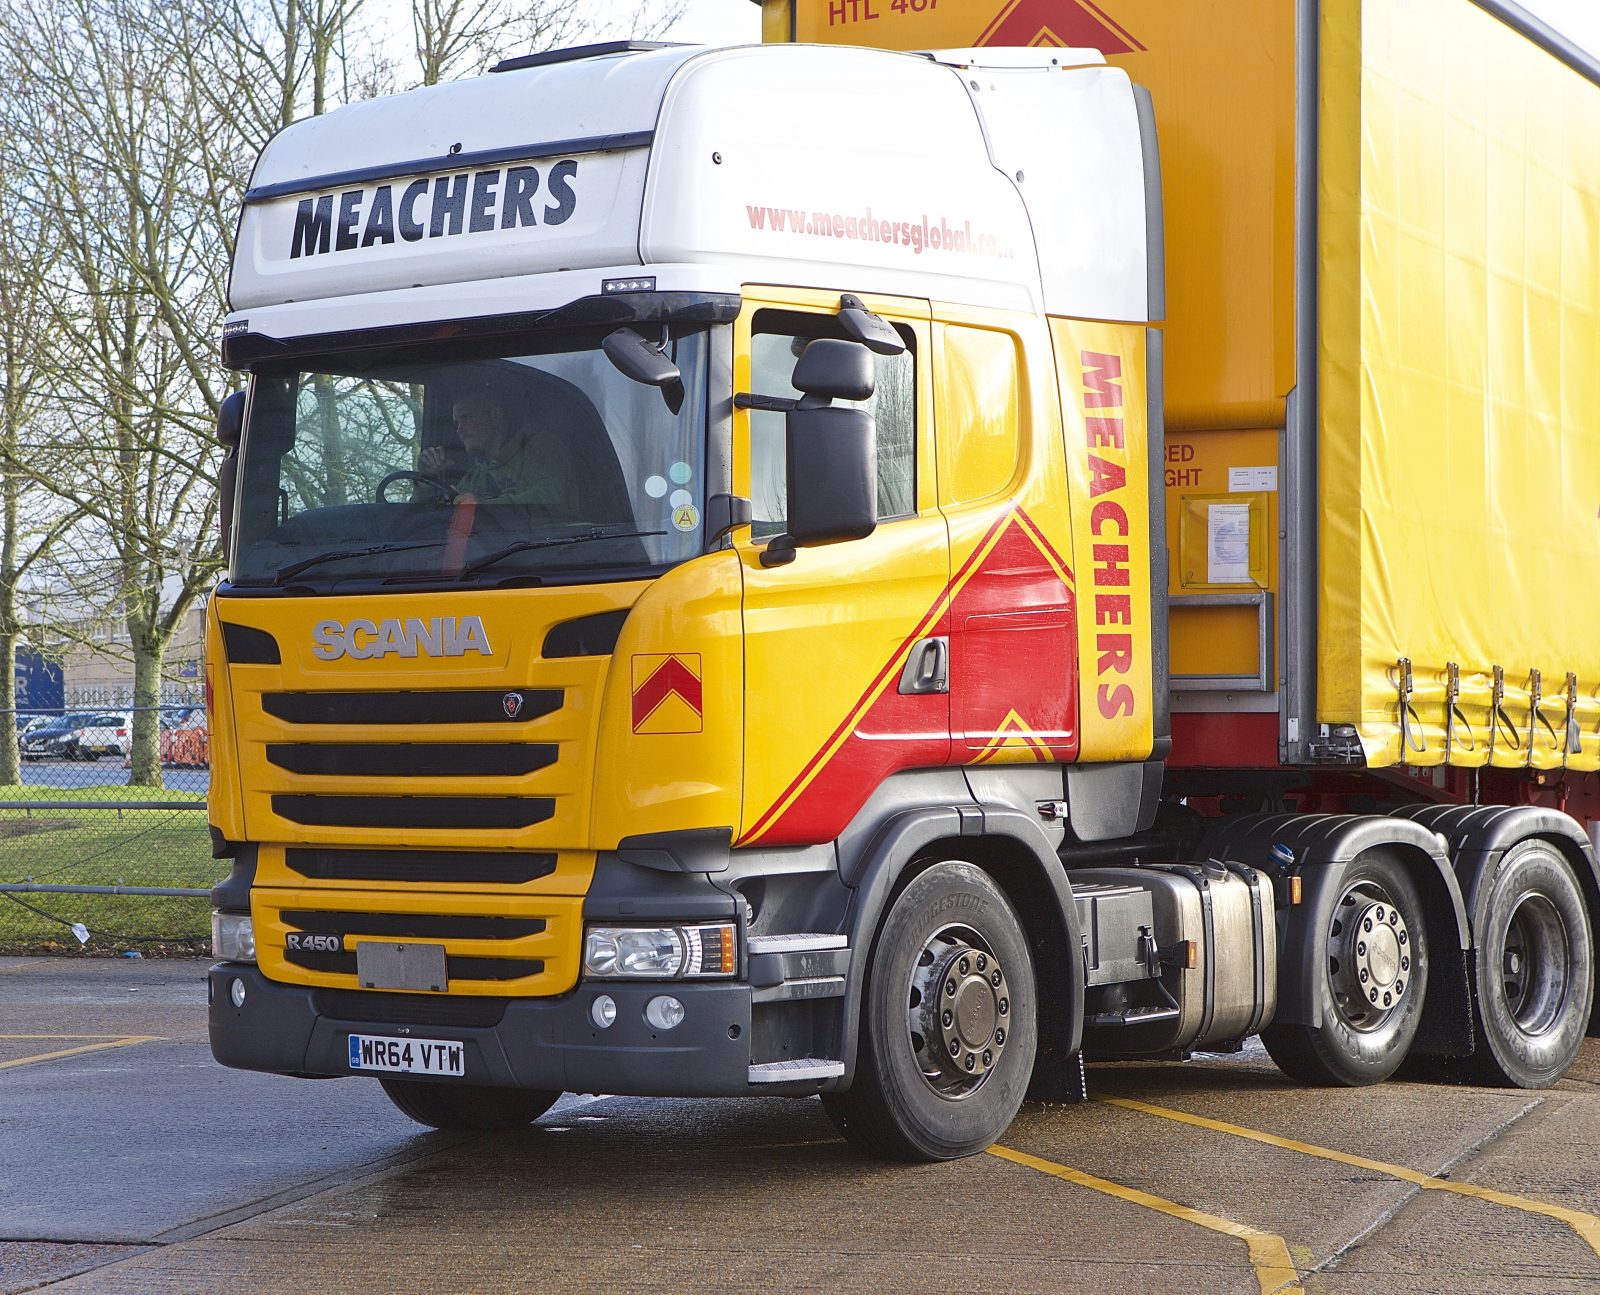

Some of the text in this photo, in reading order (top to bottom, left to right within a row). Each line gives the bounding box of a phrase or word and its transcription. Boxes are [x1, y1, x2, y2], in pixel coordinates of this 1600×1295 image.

[829, 0, 879, 26] HTL
[290, 160, 578, 259] MEACHERS
[1164, 444, 1194, 462] ED
[1081, 350, 1134, 719] MEACHERS
[312, 615, 493, 661] SCANIA
[287, 934, 339, 952] R 450
[361, 1039, 460, 1072] WR64 VTW
